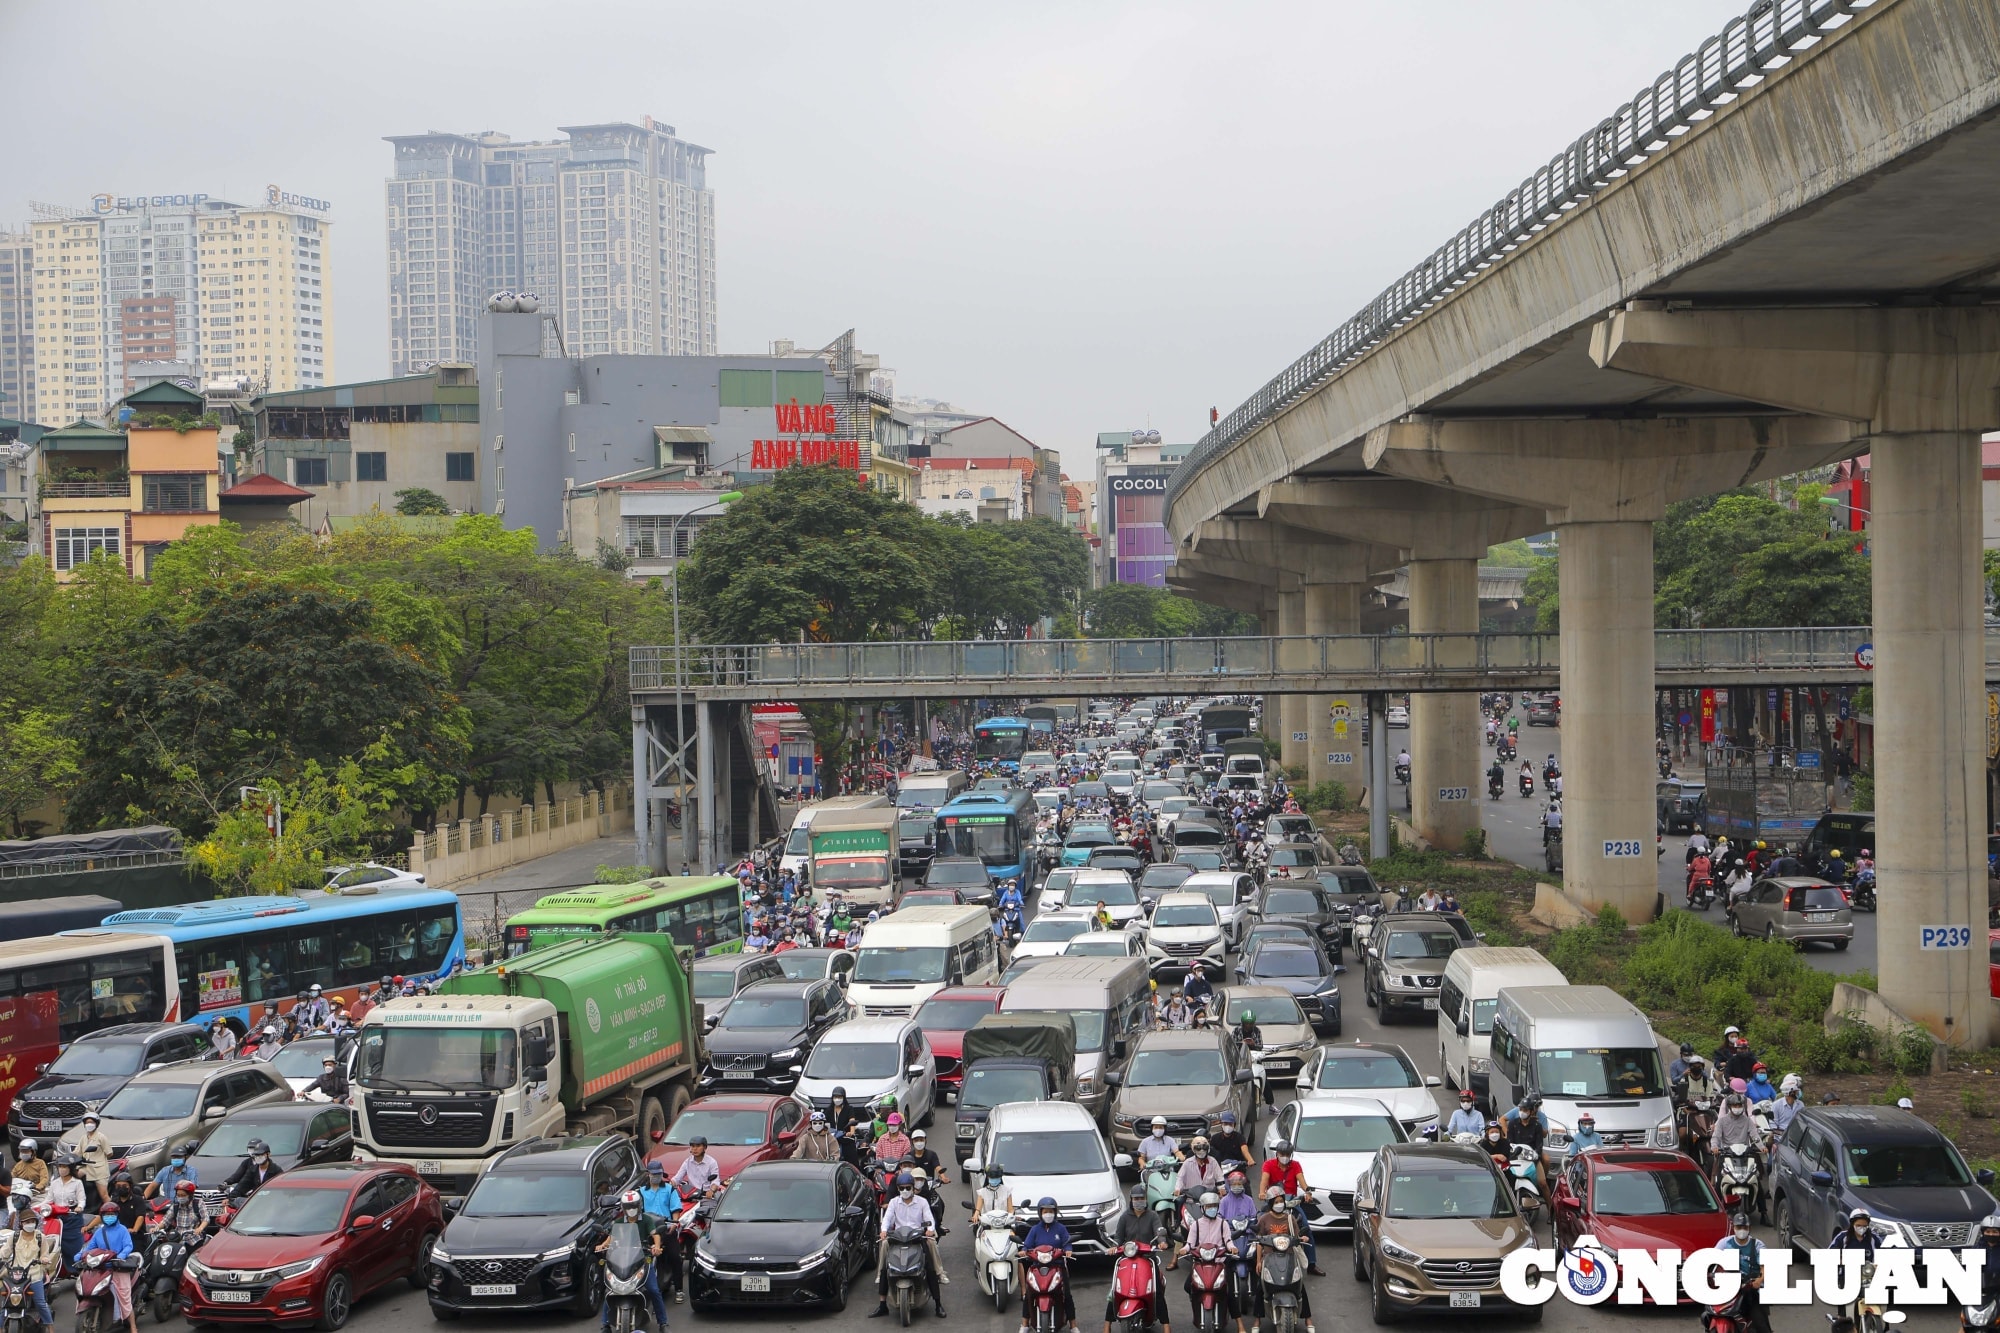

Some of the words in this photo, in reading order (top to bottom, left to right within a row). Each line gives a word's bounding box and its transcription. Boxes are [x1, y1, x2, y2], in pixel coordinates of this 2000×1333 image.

[117, 198, 147, 208] FLC
[152, 194, 208, 207] GROUP
[282, 192, 298, 205] FLC
[300, 196, 331, 211] GROUP
[775, 397, 836, 433] VÀNG
[752, 440, 797, 469] ANH
[801, 440, 859, 470] MINH
[1328, 753, 1352, 763] P236
[1440, 788, 1468, 800] P237
[1605, 841, 1640, 856] P238
[1922, 927, 1971, 947] P239
[623, 977, 637, 997] THỦ
[638, 975, 647, 991] ĐÔ
[212, 1292, 250, 1301] 30G-319.55
